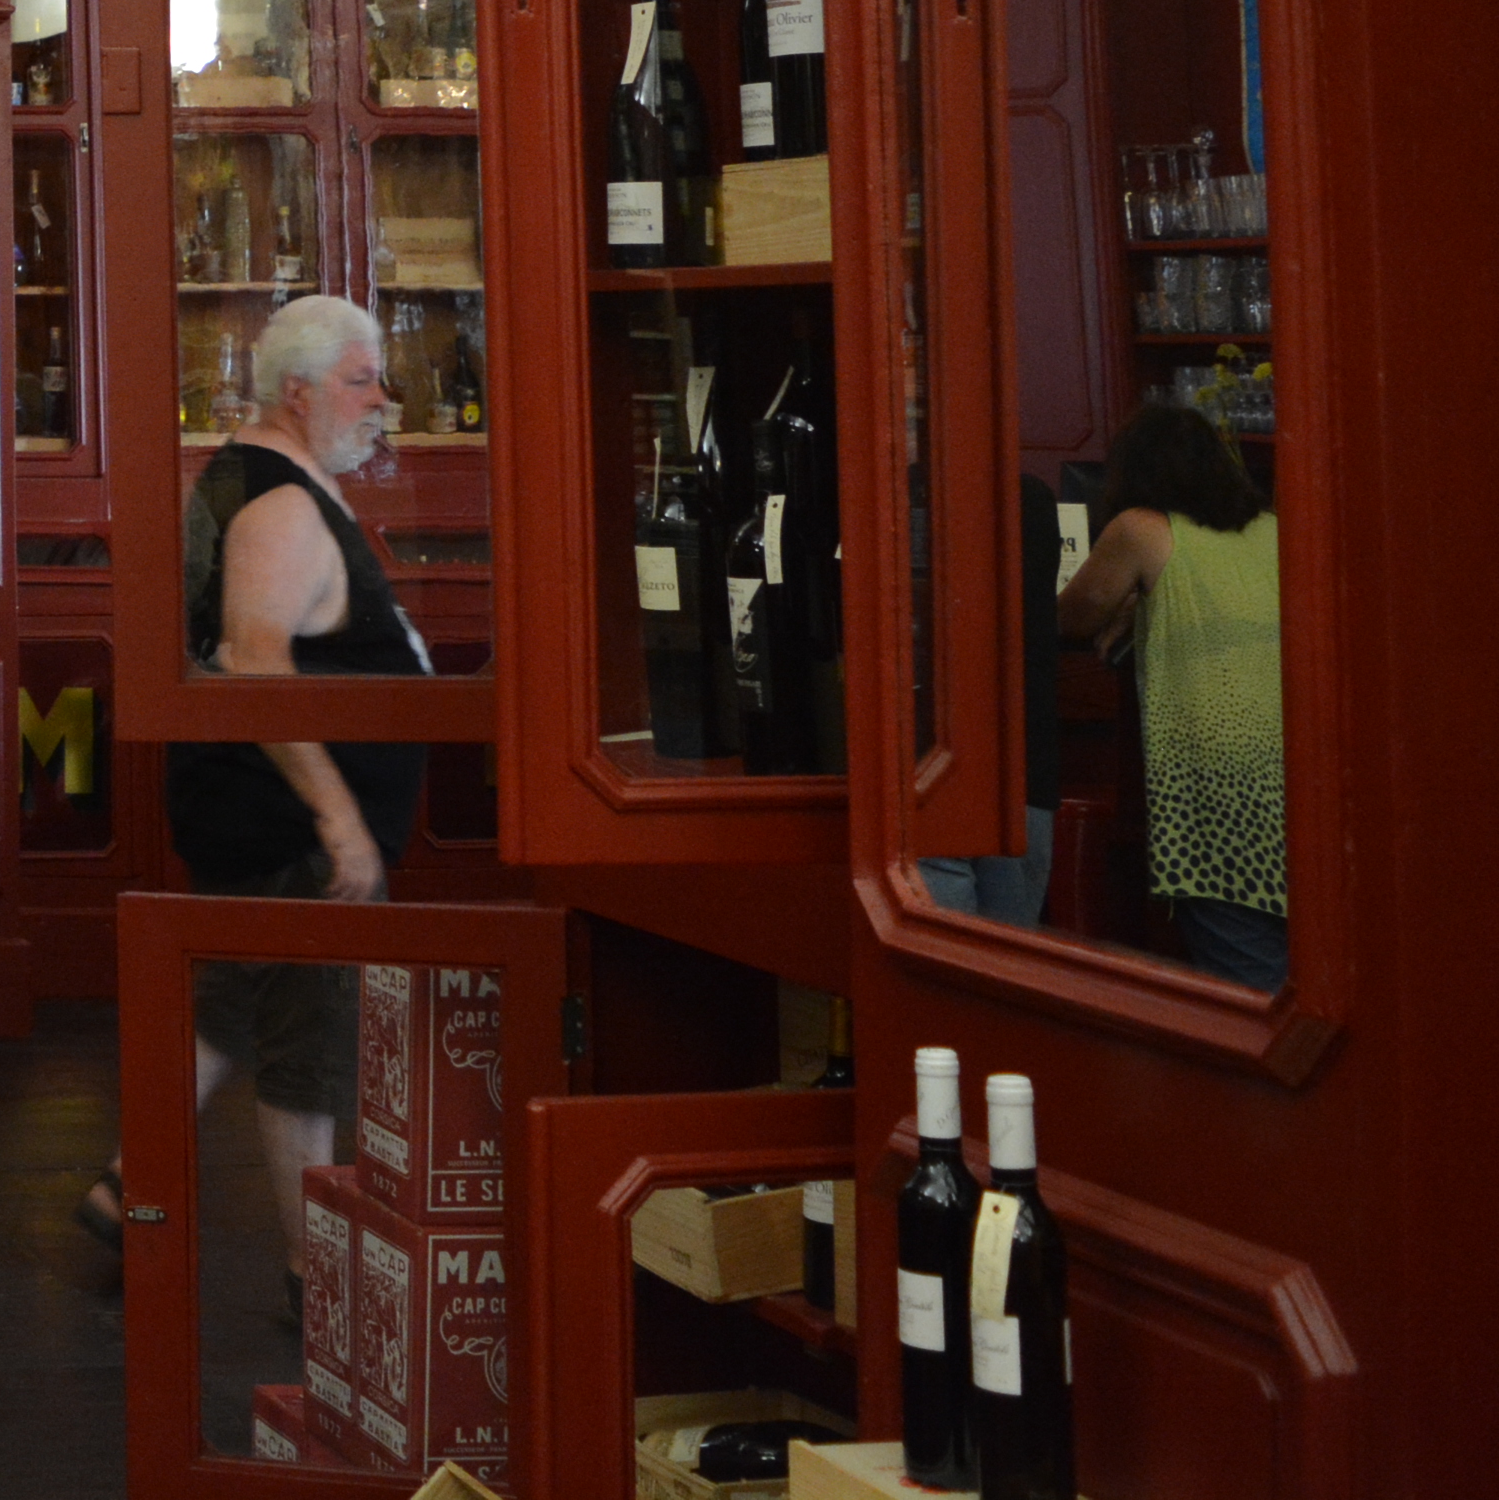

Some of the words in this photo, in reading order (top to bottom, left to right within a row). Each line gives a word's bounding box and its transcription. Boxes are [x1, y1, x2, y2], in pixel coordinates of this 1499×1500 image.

[776, 11, 813, 27] Olivier
[18, 686, 95, 795] M
[380, 967, 408, 993] CAP
[453, 1010, 487, 1029] CAP
[369, 1142, 402, 1169] BASTIA
[459, 1139, 501, 1158] L.N.
[371, 1171, 398, 1198] 1872
[440, 1179, 466, 1203] LE
[320, 1213, 348, 1241] CAP
[377, 1248, 407, 1276] CAP
[451, 1296, 486, 1316] CAP
[315, 1383, 349, 1415] BASTIA
[317, 1412, 342, 1439] 1872
[367, 1420, 407, 1455] BASTIA
[455, 1426, 500, 1444] L.N.
